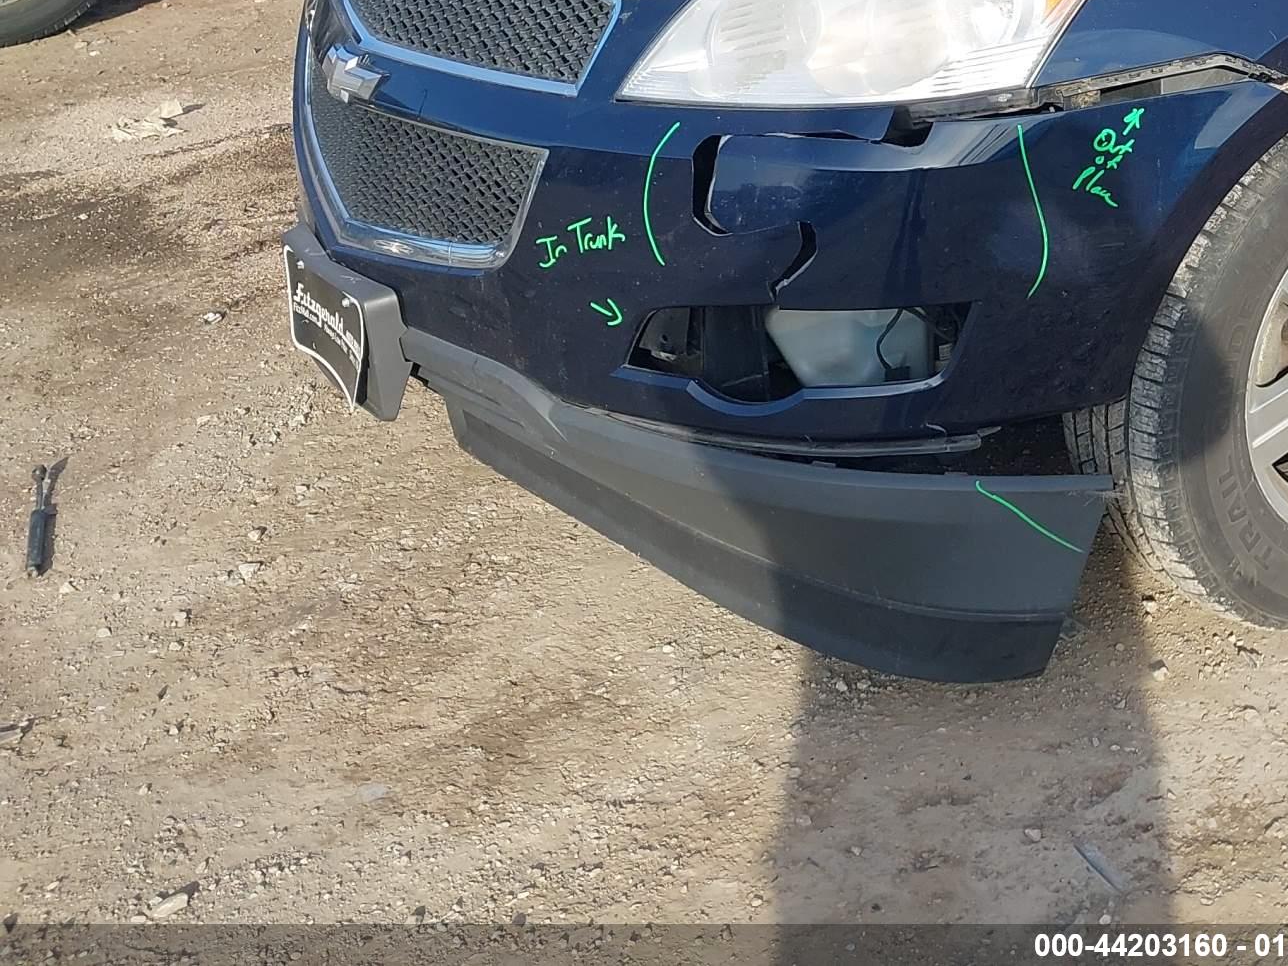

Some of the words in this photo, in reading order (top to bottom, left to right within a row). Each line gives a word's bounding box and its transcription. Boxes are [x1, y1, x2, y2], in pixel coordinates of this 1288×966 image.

[536, 235, 568, 268] In
[293, 281, 344, 335] Fitzgerald
[1217, 452, 1273, 571] TRAIL
